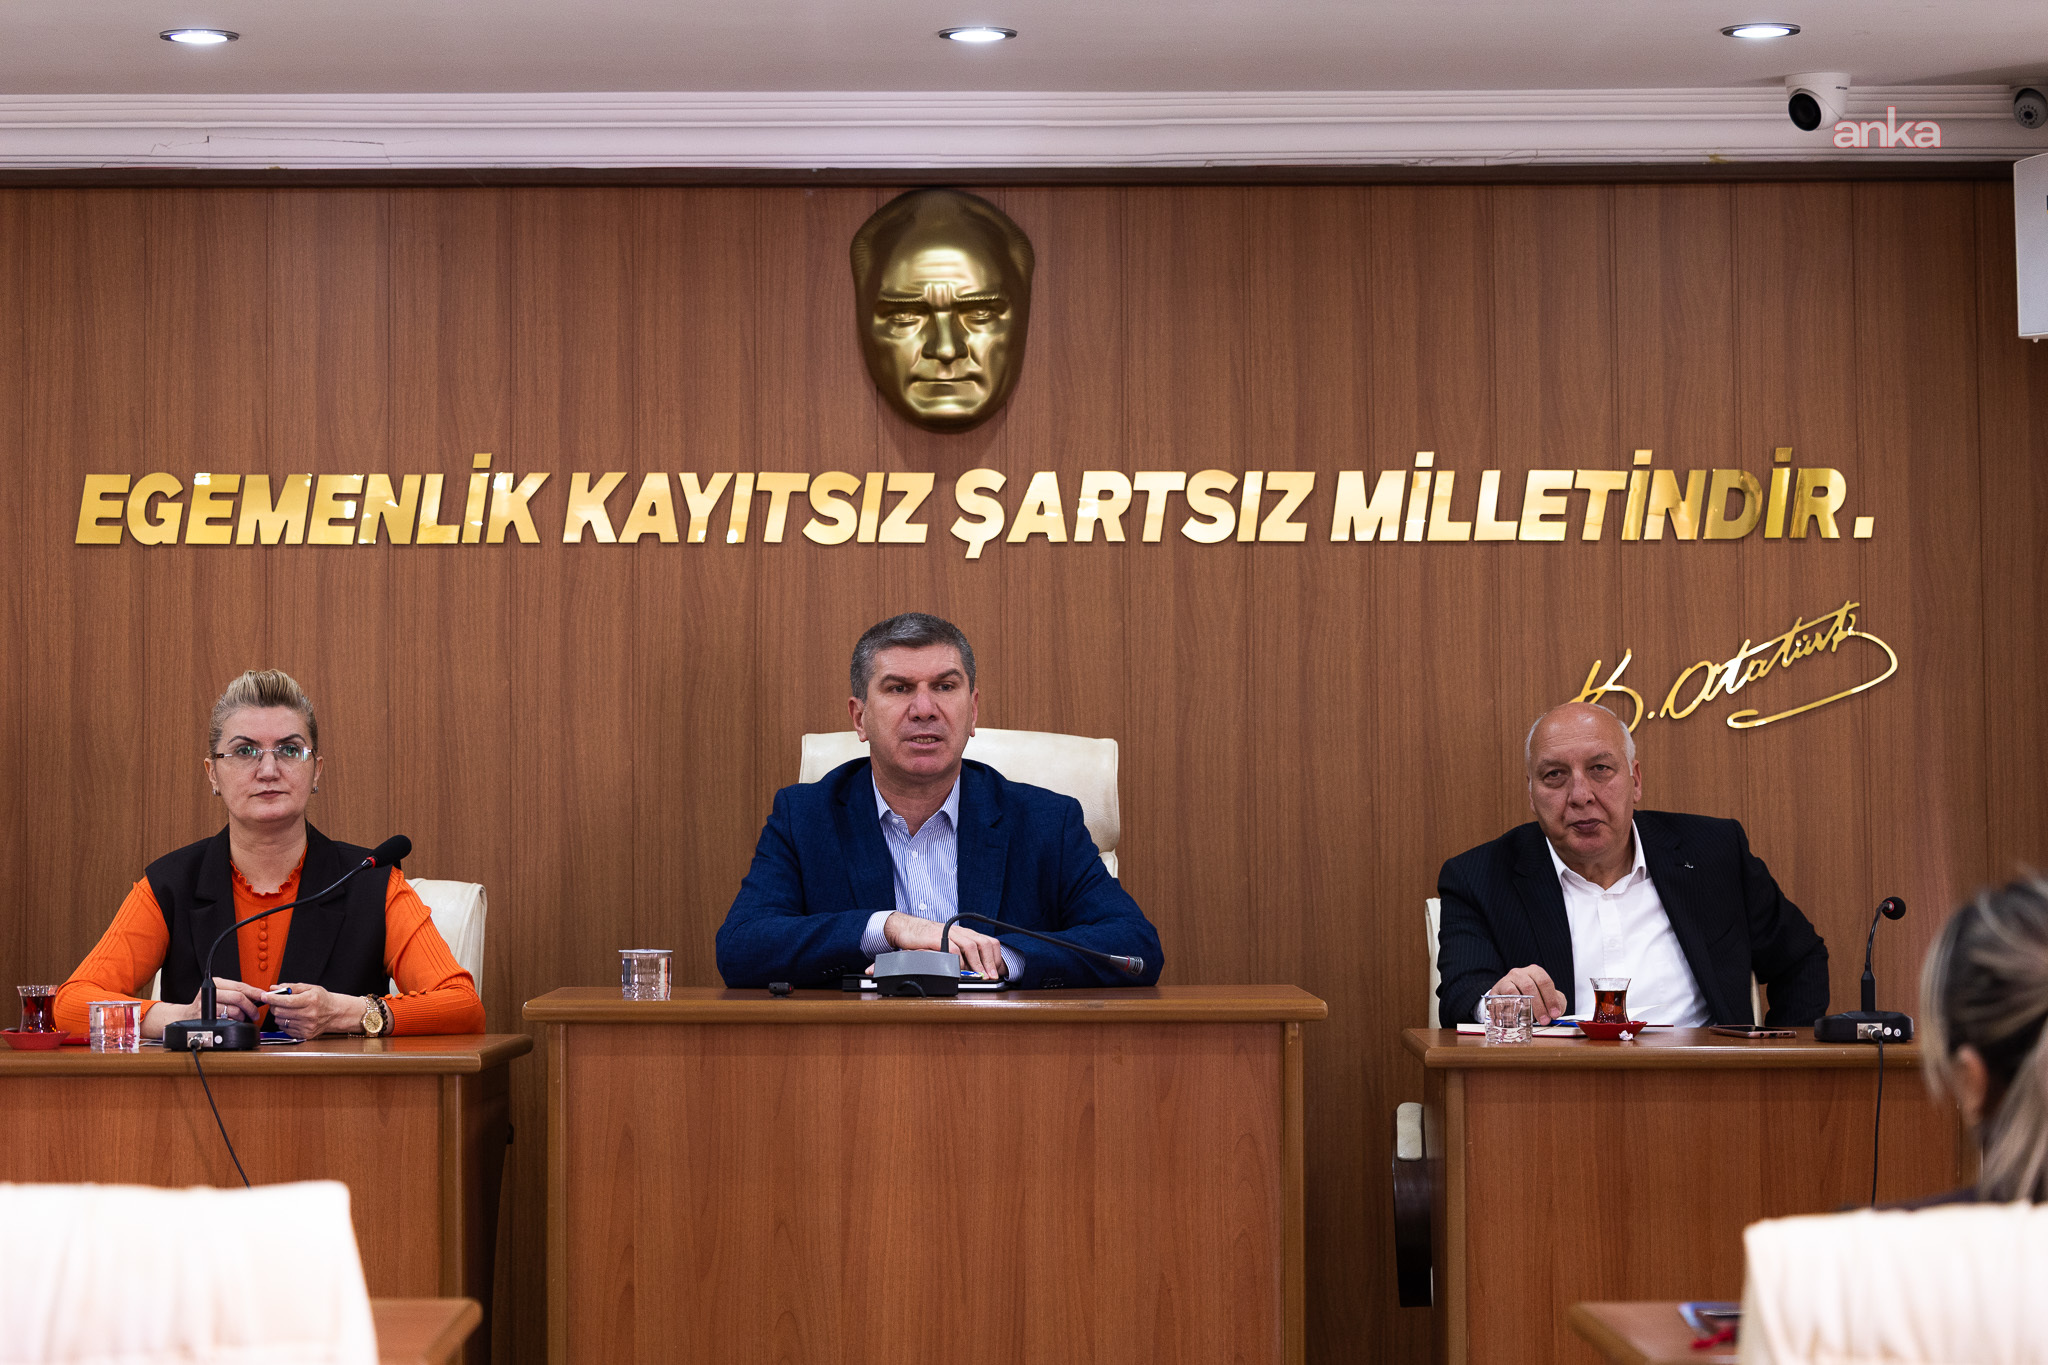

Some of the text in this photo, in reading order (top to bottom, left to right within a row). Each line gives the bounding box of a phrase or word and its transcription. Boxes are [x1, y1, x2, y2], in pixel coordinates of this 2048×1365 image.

[74, 447, 1875, 559] EGEMENLİK KAYITSIZ ŞARTSIZ MİLLETİNDİR.
